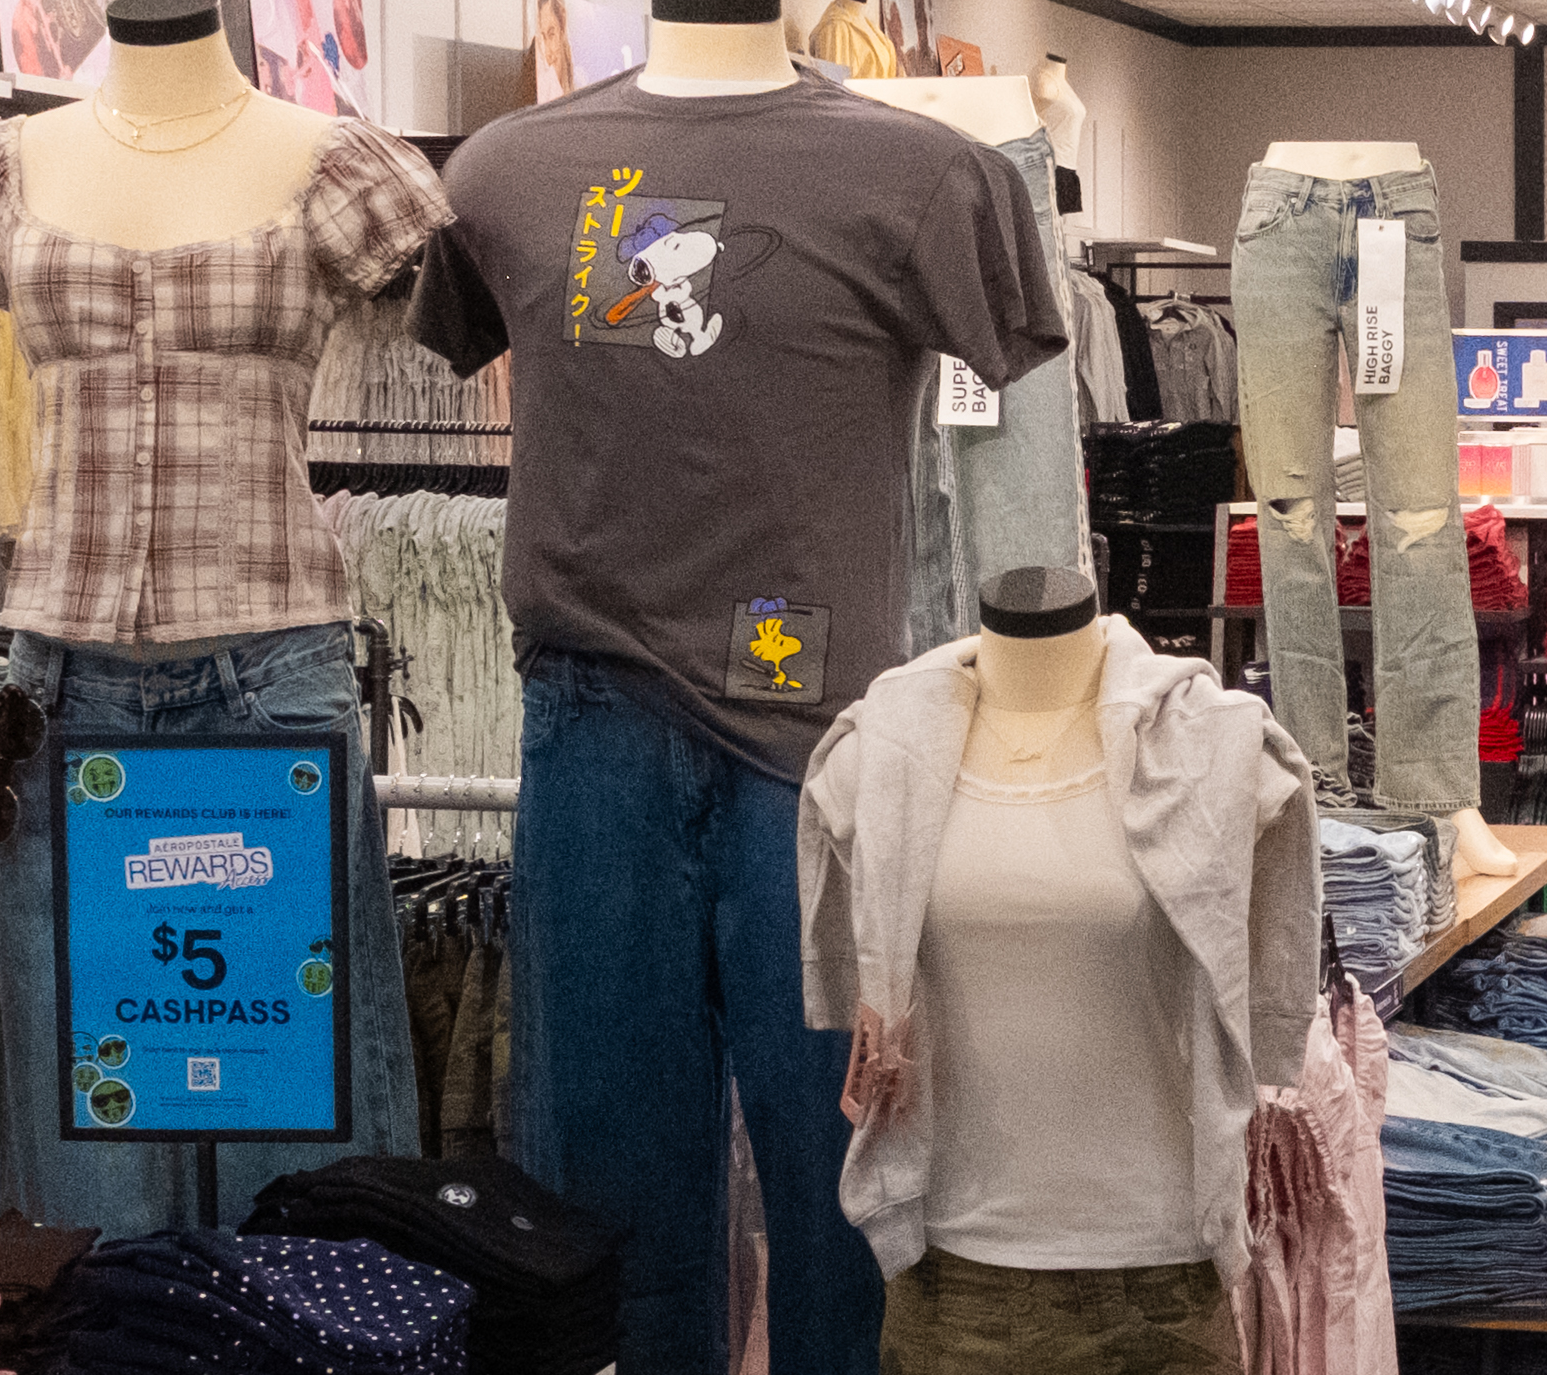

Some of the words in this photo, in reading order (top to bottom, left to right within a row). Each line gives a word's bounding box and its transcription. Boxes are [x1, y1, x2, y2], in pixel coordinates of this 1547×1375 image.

[1366, 306, 1378, 341] RISE
[1364, 345, 1378, 384] HIGH
[1379, 329, 1394, 384] BAGGY
[1496, 340, 1509, 376] SWEET
[952, 361, 967, 413] SUPE
[1496, 380, 1509, 412] TREAT
[104, 808, 133, 819] OUR
[135, 808, 199, 819] REWARDS
[202, 808, 236, 819] CLUB
[239, 808, 251, 819] IS
[128, 850, 269, 883] REWARDS
[152, 921, 227, 991] $5
[115, 998, 291, 1025] CASHPASS
